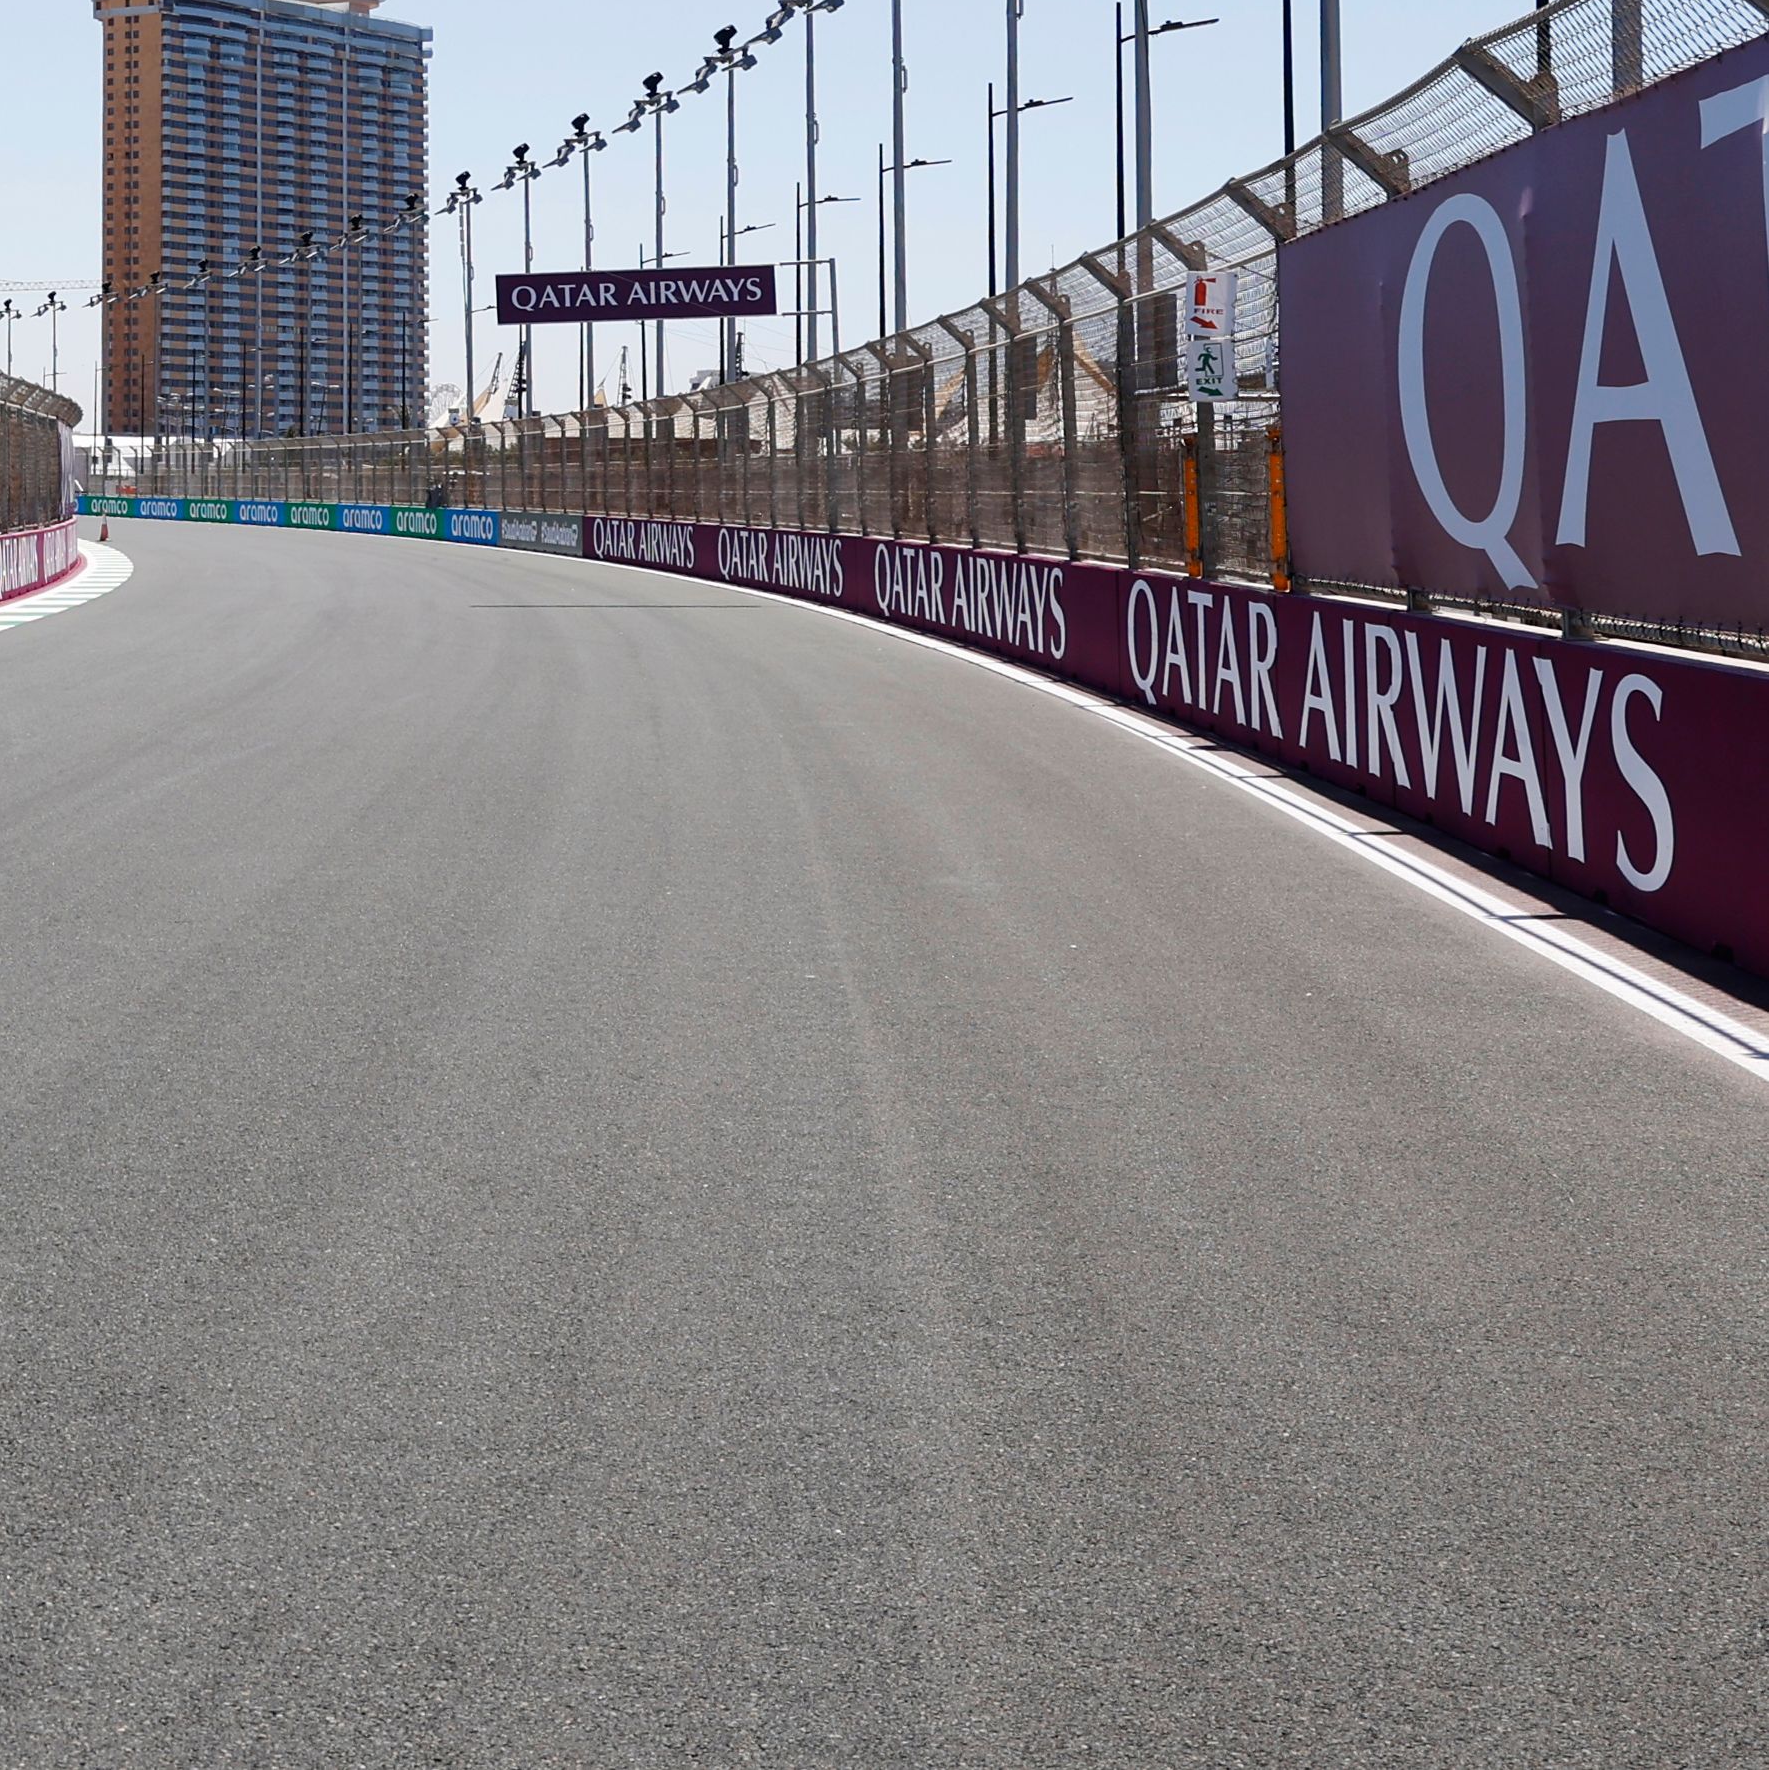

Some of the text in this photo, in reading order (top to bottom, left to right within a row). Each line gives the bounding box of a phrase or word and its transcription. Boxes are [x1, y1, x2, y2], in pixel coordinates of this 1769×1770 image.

[511, 278, 763, 311] QATAR AIRWAYS
[1196, 377, 1223, 385] EXIT
[91, 498, 128, 515] aramco
[140, 500, 177, 518] aramco
[189, 502, 228, 520] aramco
[239, 504, 278, 523] aramco
[290, 506, 330, 526] aramco
[342, 508, 383, 530] aramco
[396, 510, 437, 535] aramco
[451, 513, 494, 541] aramco
[593, 518, 695, 569] QATAR AIRWAYS
[718, 529, 843, 598] QATAR AIRWAYS
[874, 542, 1067, 660] QATAR AIRWAYS
[1126, 578, 1674, 893] QATAR AIRWAYS
